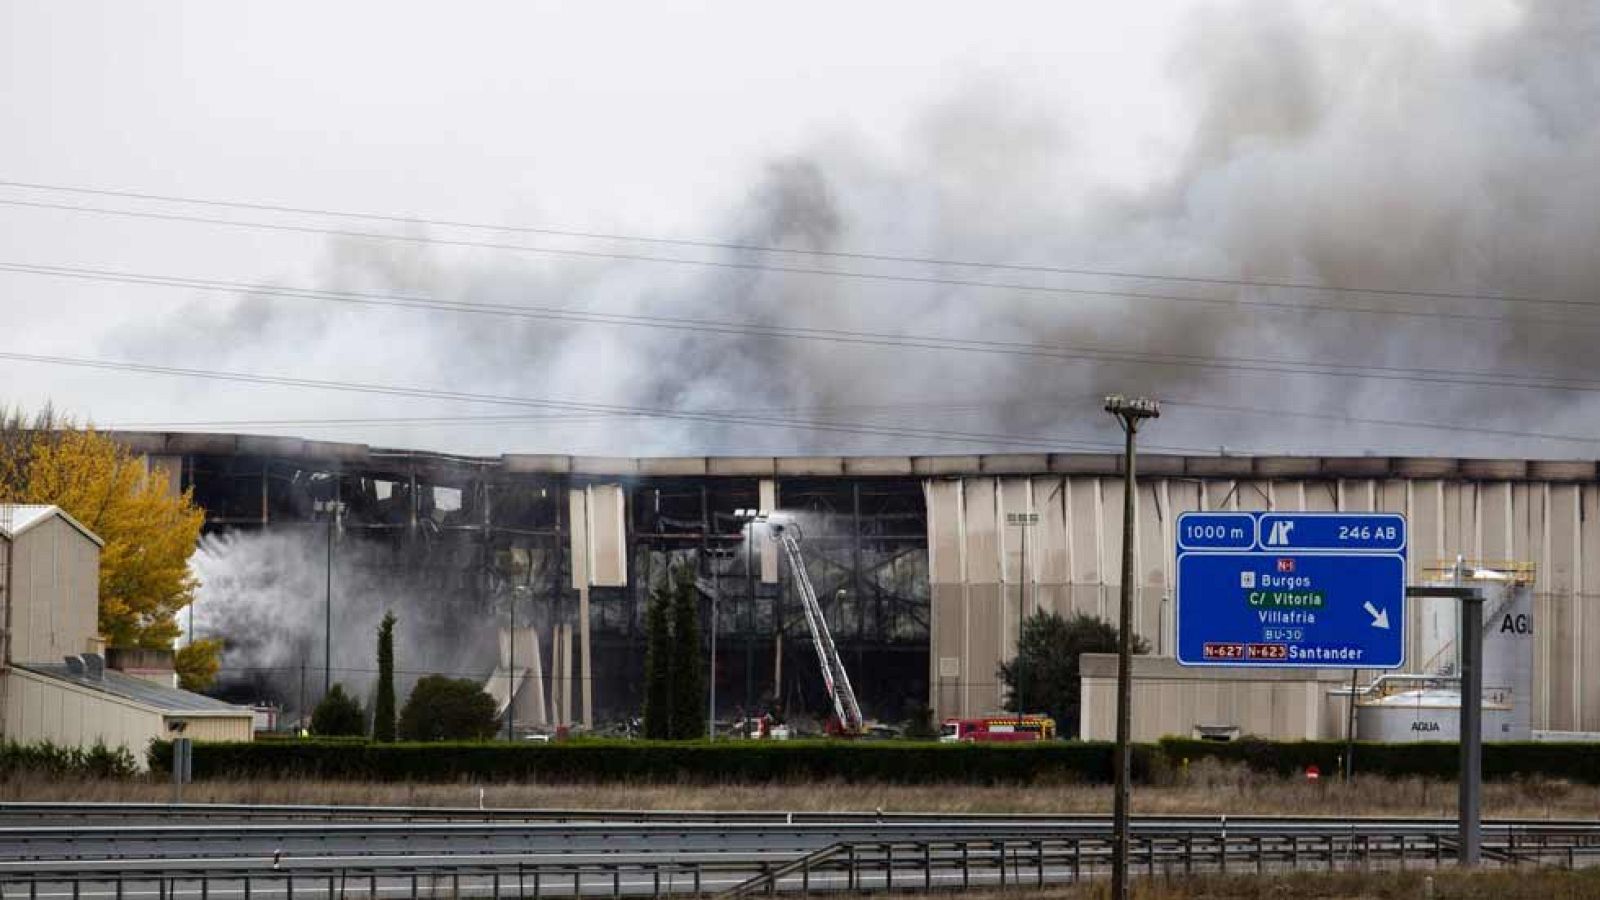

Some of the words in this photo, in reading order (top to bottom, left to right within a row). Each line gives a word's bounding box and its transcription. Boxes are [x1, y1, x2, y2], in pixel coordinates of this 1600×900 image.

[1187, 526, 1225, 539] 1000
[1230, 528, 1243, 539] m
[1338, 526, 1371, 540] 246
[1374, 526, 1396, 540] AB
[1261, 574, 1311, 590] Burgos
[1250, 592, 1264, 606] C/
[1274, 593, 1322, 606] Vitoria
[1265, 630, 1302, 640] BU-30
[1205, 646, 1242, 656] N-627
[1248, 646, 1286, 657] N-623
[1289, 646, 1363, 659] Santander
[1411, 721, 1440, 732] AGUA
